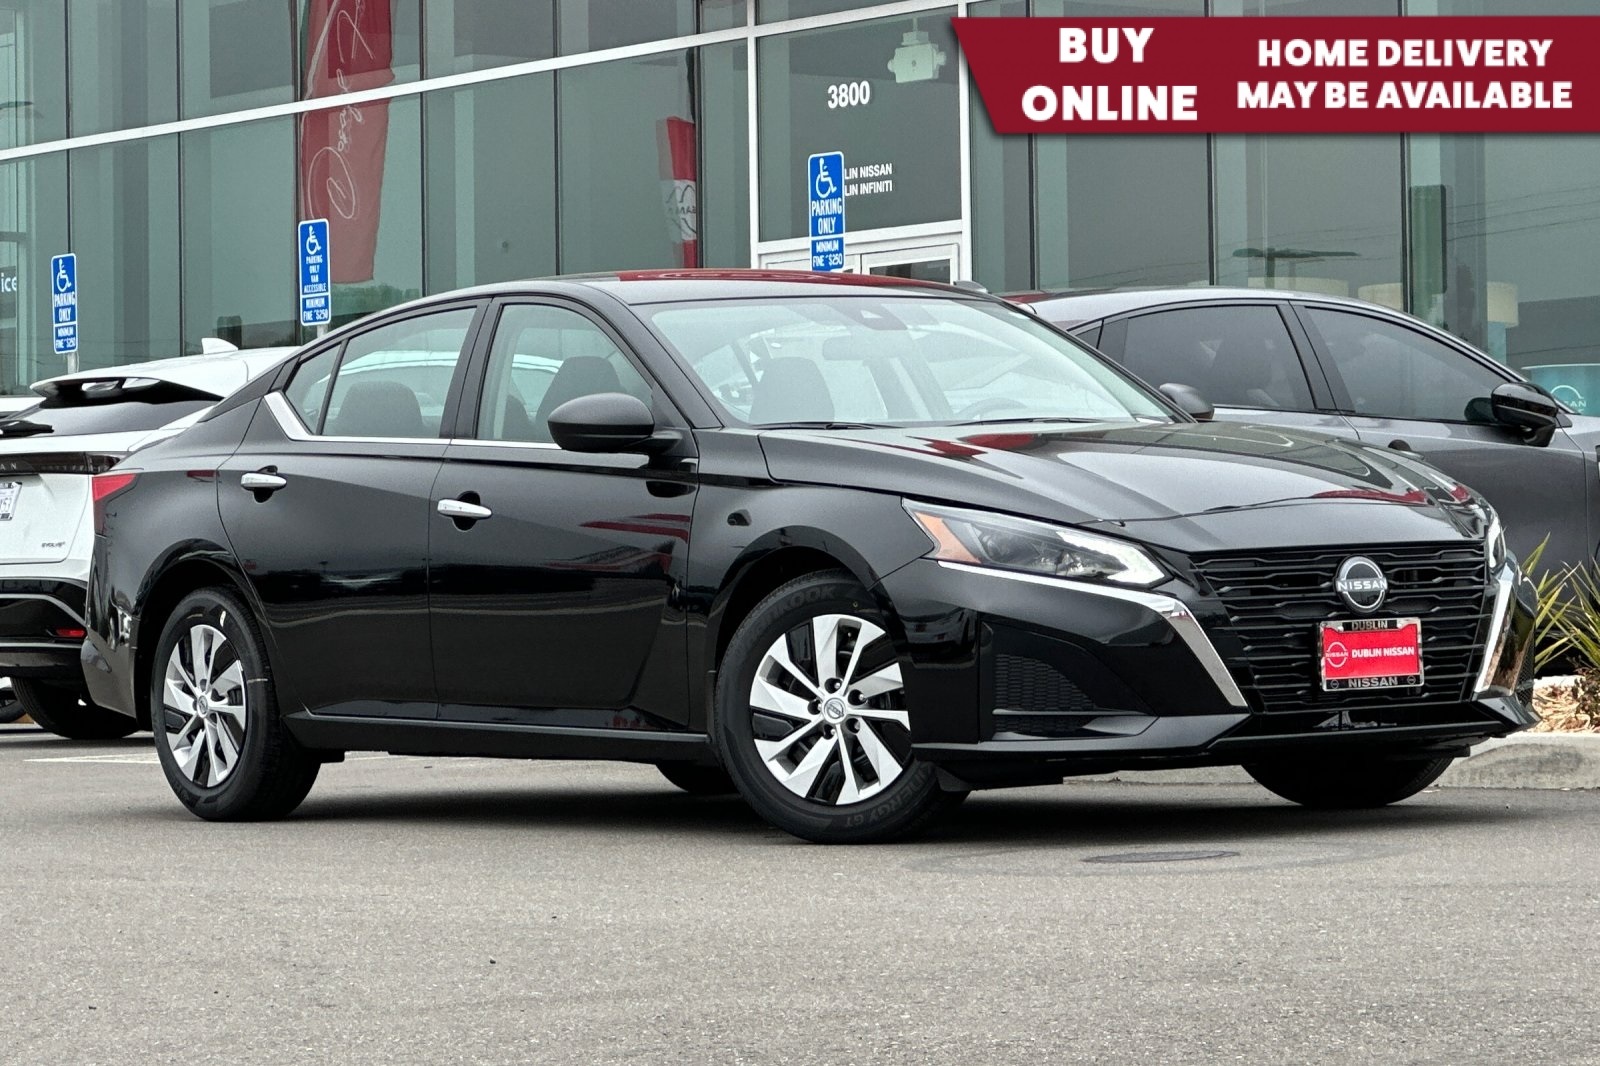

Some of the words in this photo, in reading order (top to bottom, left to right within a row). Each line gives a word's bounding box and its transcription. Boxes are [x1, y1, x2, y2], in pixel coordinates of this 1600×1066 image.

[827, 80, 871, 109] 3800
[860, 163, 893, 178] NISSAN
[860, 180, 893, 195] INFINITI
[811, 197, 843, 217] PARKING
[817, 217, 837, 235] ONLY
[816, 240, 839, 253] MINIMUM
[306, 255, 323, 264] PARKING
[812, 255, 825, 267] FINE
[309, 265, 320, 274] ONLY
[54, 291, 76, 307] PARKING
[59, 307, 72, 322] ONLY
[303, 310, 313, 321] FINE
[1337, 579, 1387, 591] NISSAN
[1351, 620, 1388, 631] DUBLIN
[1351, 648, 1382, 659] DUBLIN
[1383, 646, 1415, 657] NISSAN
[1348, 675, 1398, 688] NISSAN
